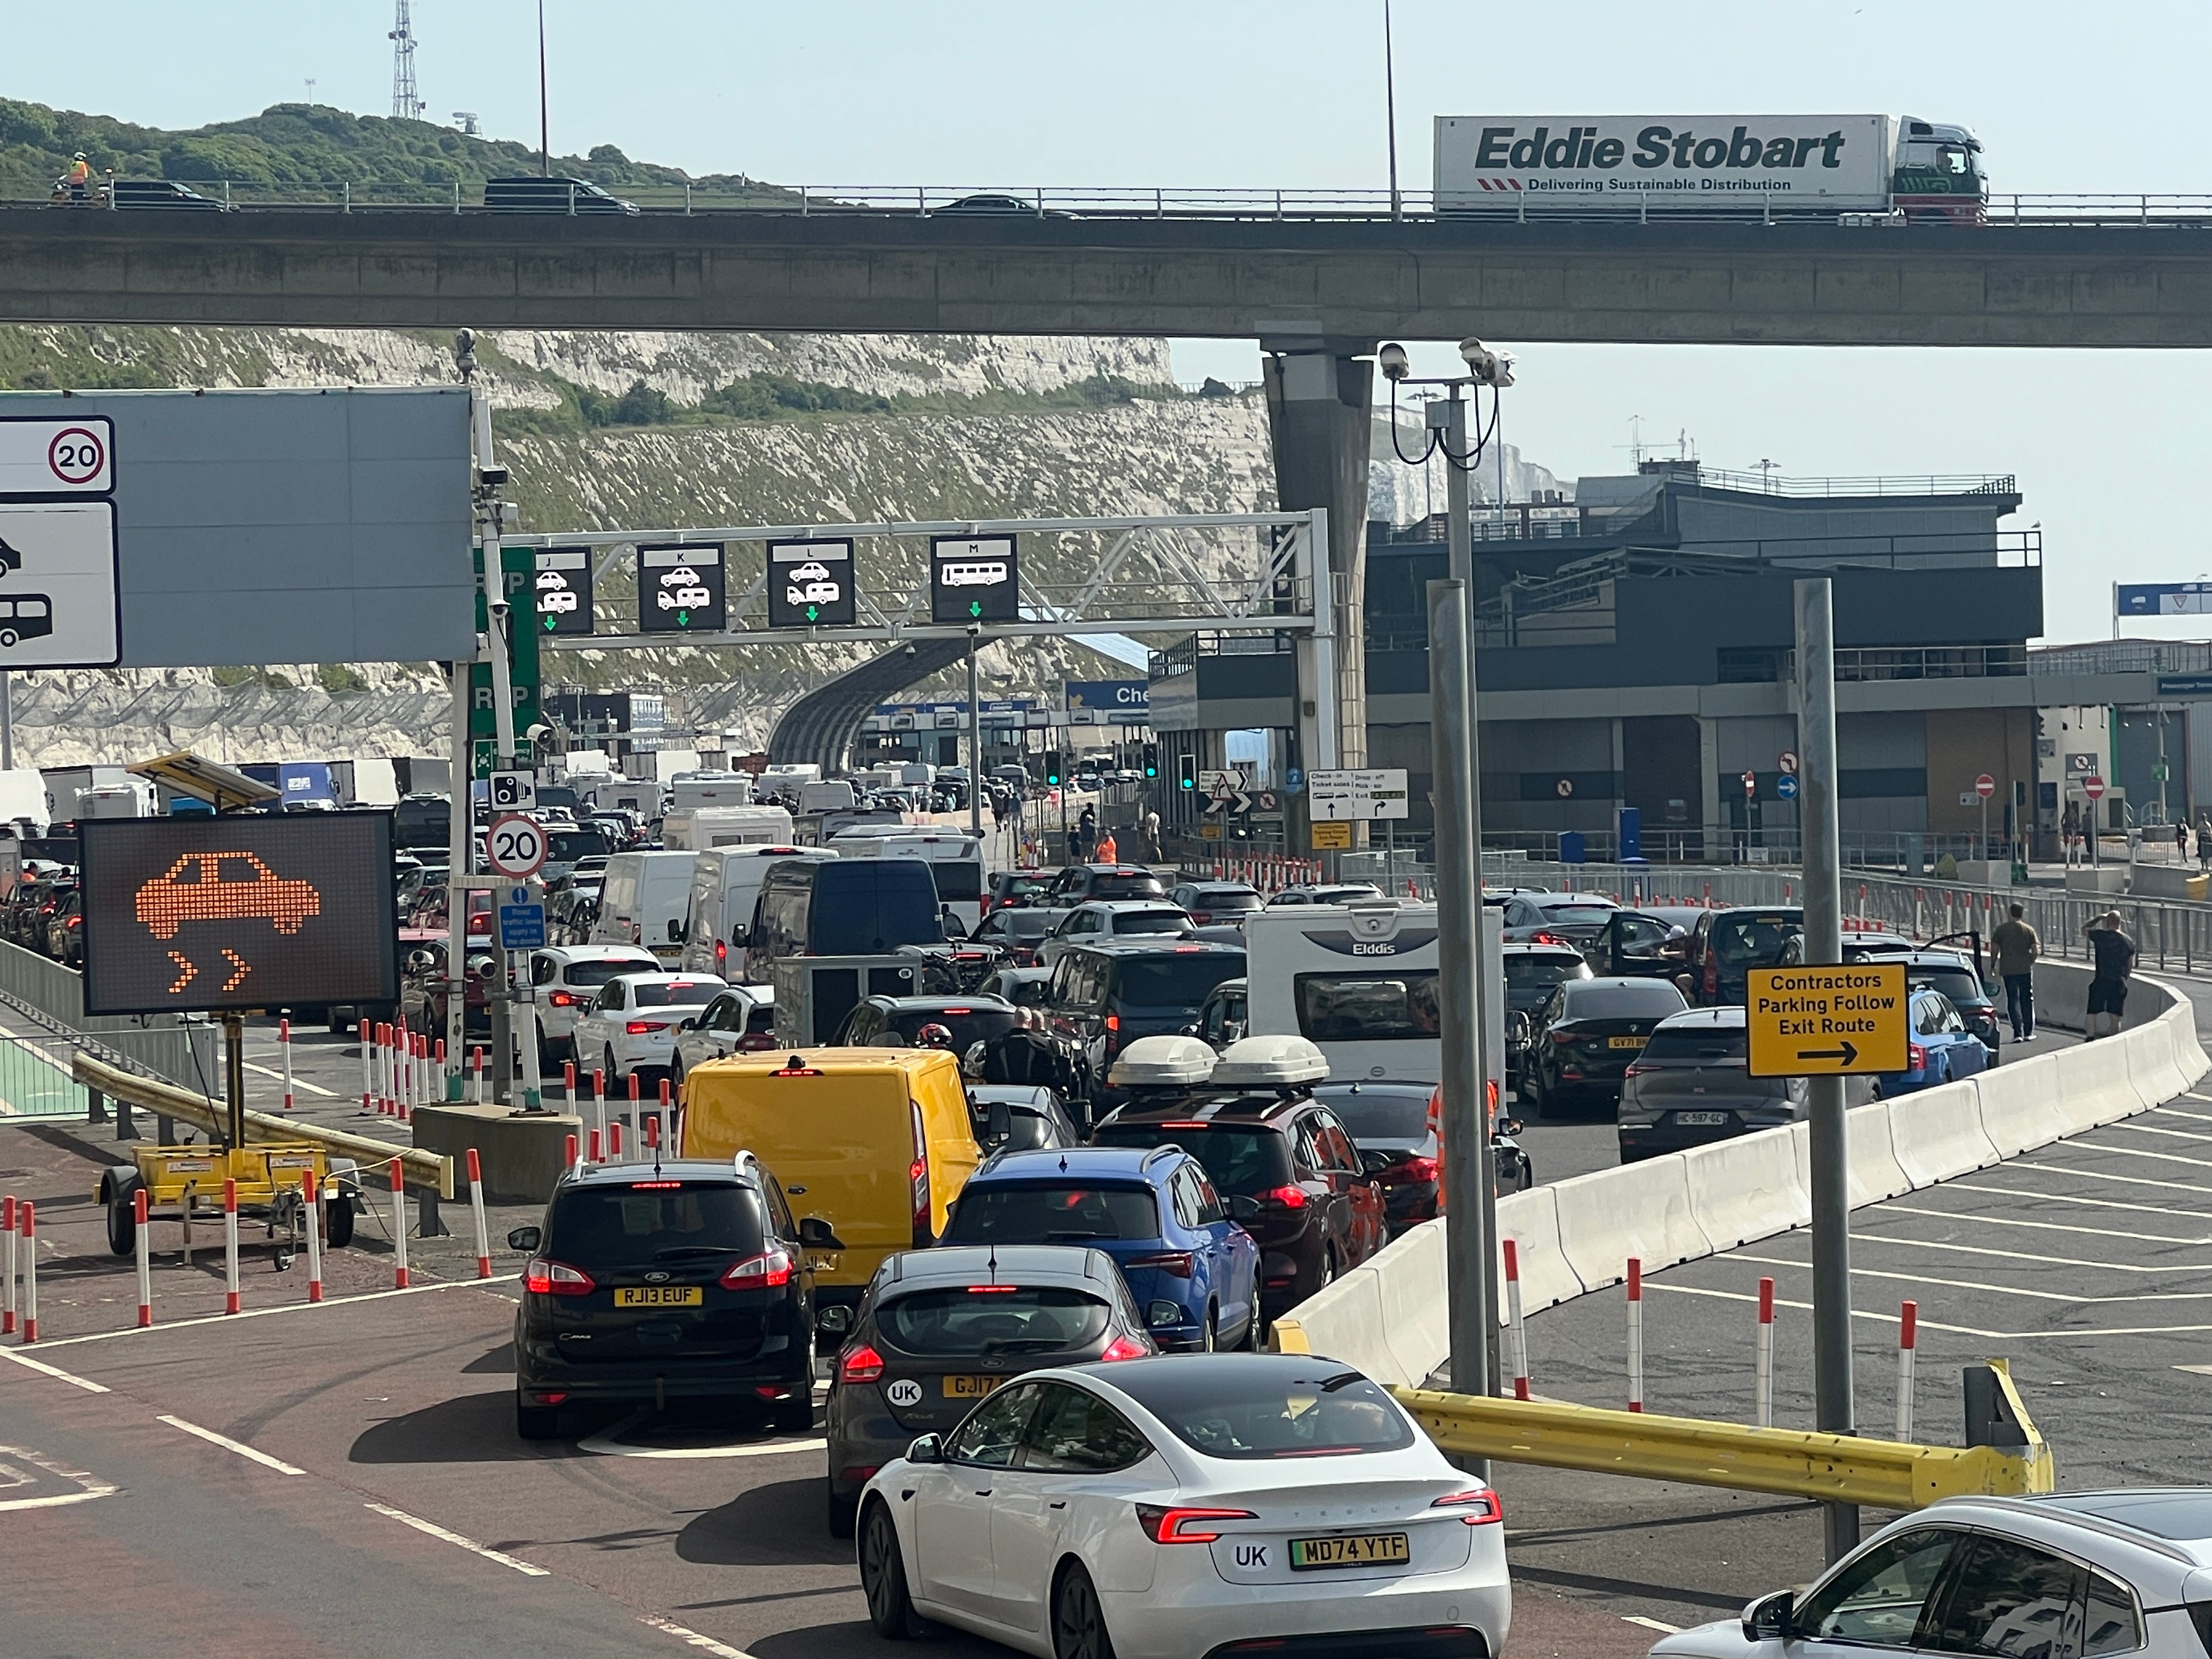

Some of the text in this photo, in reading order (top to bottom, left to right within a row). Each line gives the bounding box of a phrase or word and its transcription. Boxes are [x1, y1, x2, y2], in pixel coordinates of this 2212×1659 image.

[1475, 126, 1846, 169] Eddie Stobart
[1528, 178, 1791, 192] Delivering Sustainable Distribution
[59, 445, 97, 467] 20
[677, 552, 685, 562] K
[808, 548, 814, 557] L
[969, 544, 979, 554] M
[545, 557, 551, 567] J
[475, 686, 528, 709] RP
[496, 831, 537, 861] 20
[1353, 943, 1396, 955] Elddis
[1771, 973, 1882, 991] Contractors
[1758, 995, 1895, 1014] Parking Follow
[1779, 1017, 1876, 1035] Exit Route
[624, 1288, 691, 1304] RJ13 EUF
[891, 1386, 917, 1400] UK
[955, 1377, 994, 1393] GJ17
[1235, 1546, 1267, 1566] UK
[1305, 1536, 1403, 1561] MD74 YTF
